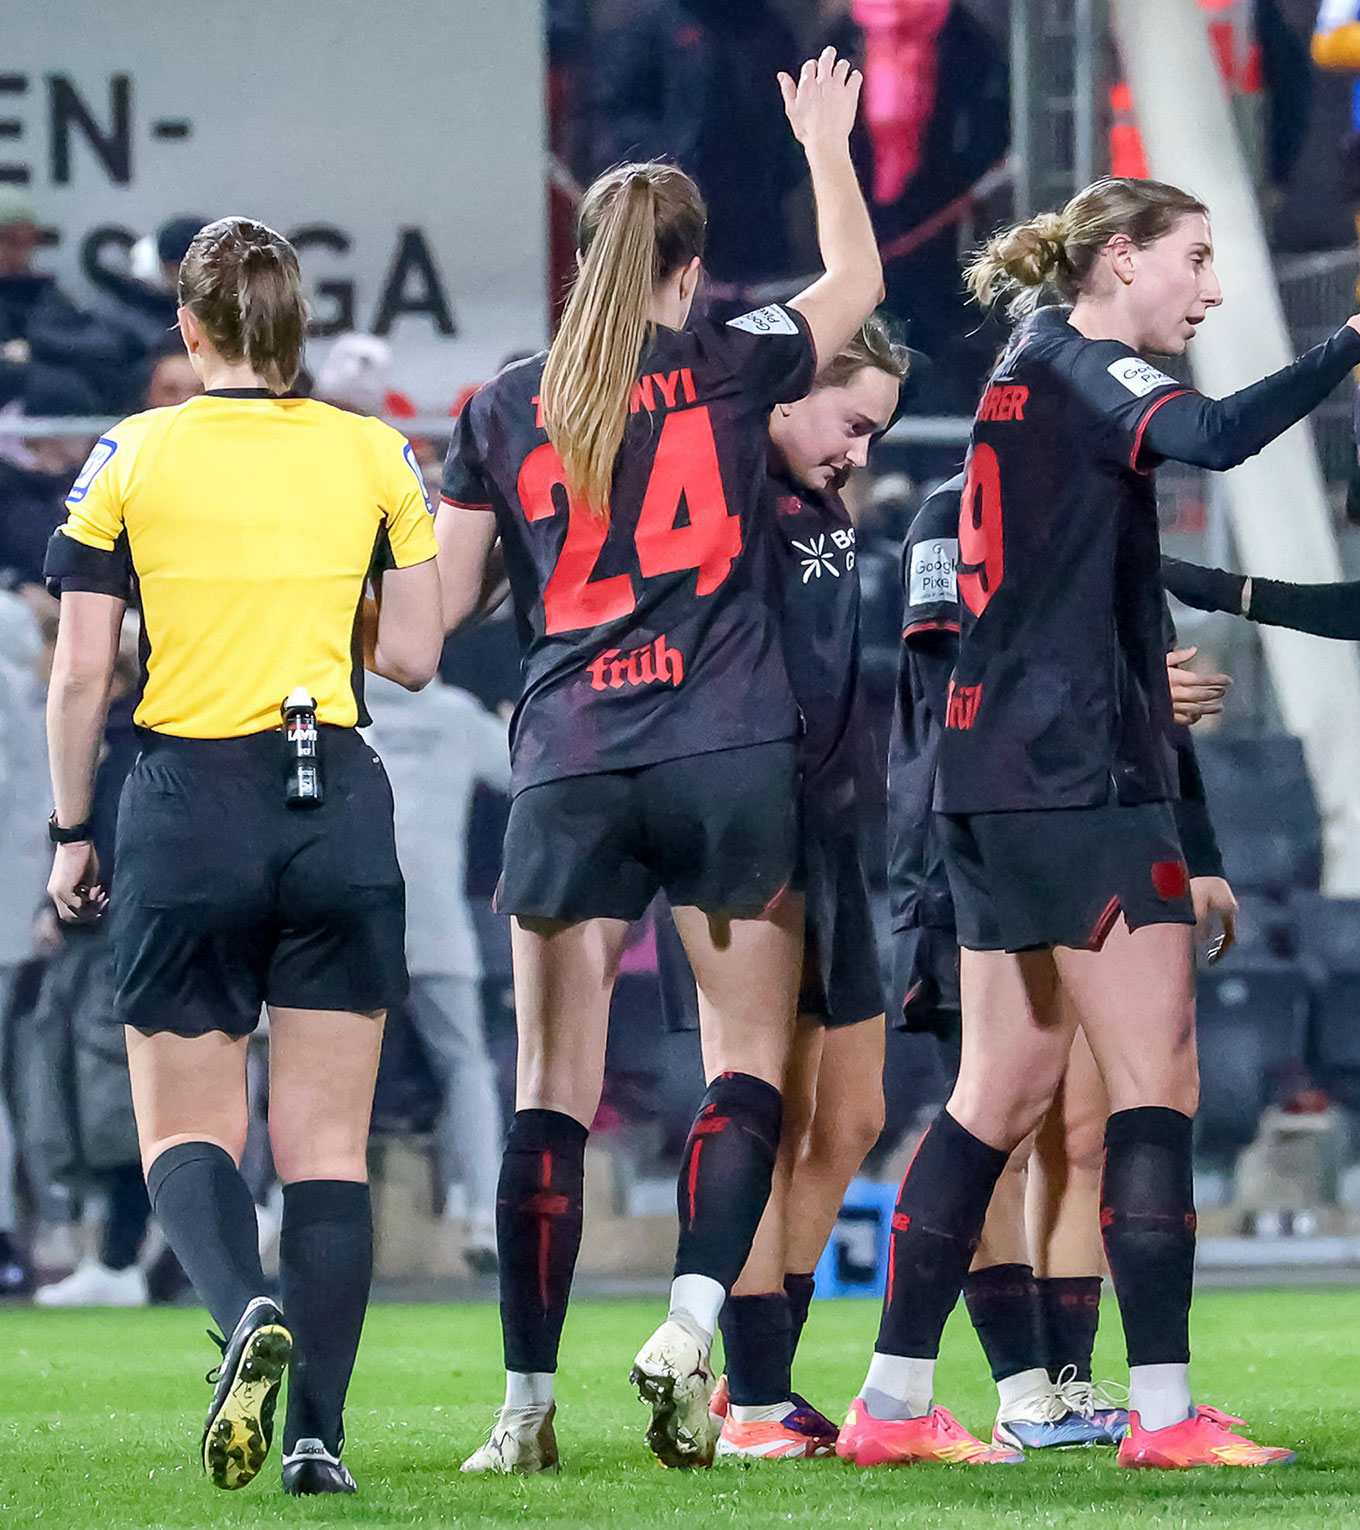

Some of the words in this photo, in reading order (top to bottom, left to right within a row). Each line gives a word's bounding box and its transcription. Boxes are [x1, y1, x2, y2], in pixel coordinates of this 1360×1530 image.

[517, 404, 742, 636] 24
[915, 558, 955, 575] Googl
[585, 633, 685, 692] früh
